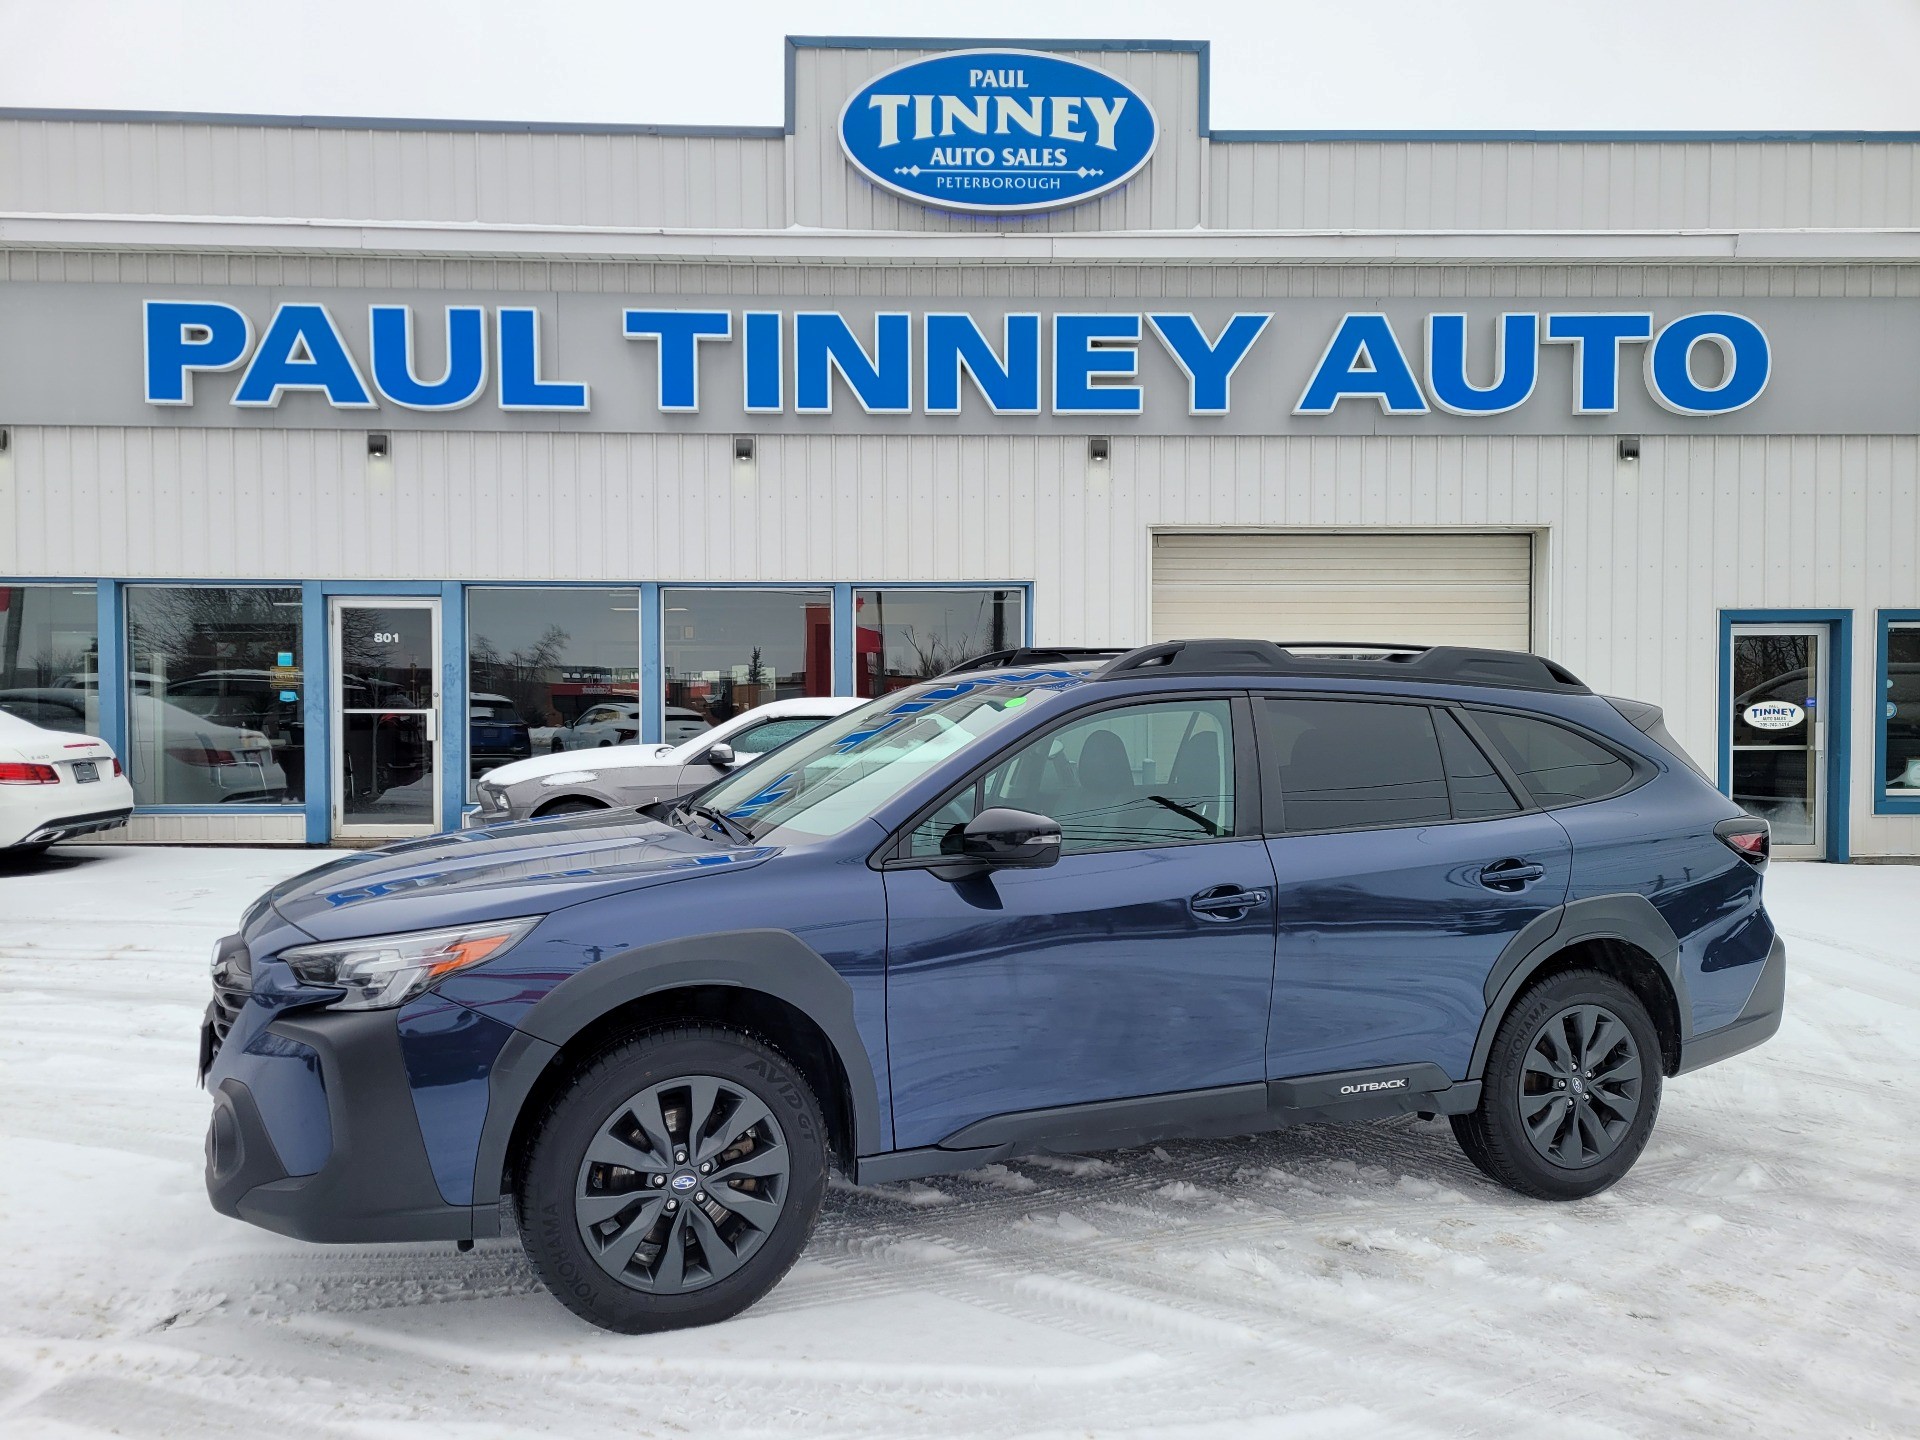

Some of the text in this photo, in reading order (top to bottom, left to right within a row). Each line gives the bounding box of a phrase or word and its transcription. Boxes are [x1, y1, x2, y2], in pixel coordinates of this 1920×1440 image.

[969, 69, 1029, 88] PAUL
[868, 94, 1129, 151] TINNEY
[930, 147, 1068, 167] AUTO SALES
[936, 176, 1061, 190] PETERBOROUGH
[142, 298, 1772, 418] PAUL TINNEY AUTO
[374, 632, 399, 643] 801
[1752, 708, 1796, 718] TINNEY
[1504, 1002, 1550, 1078] YOKOHAMA
[1340, 1079, 1406, 1094] OUTBACK
[744, 1060, 816, 1144] AVID GT
[543, 1203, 600, 1307] YOKOHAMA
